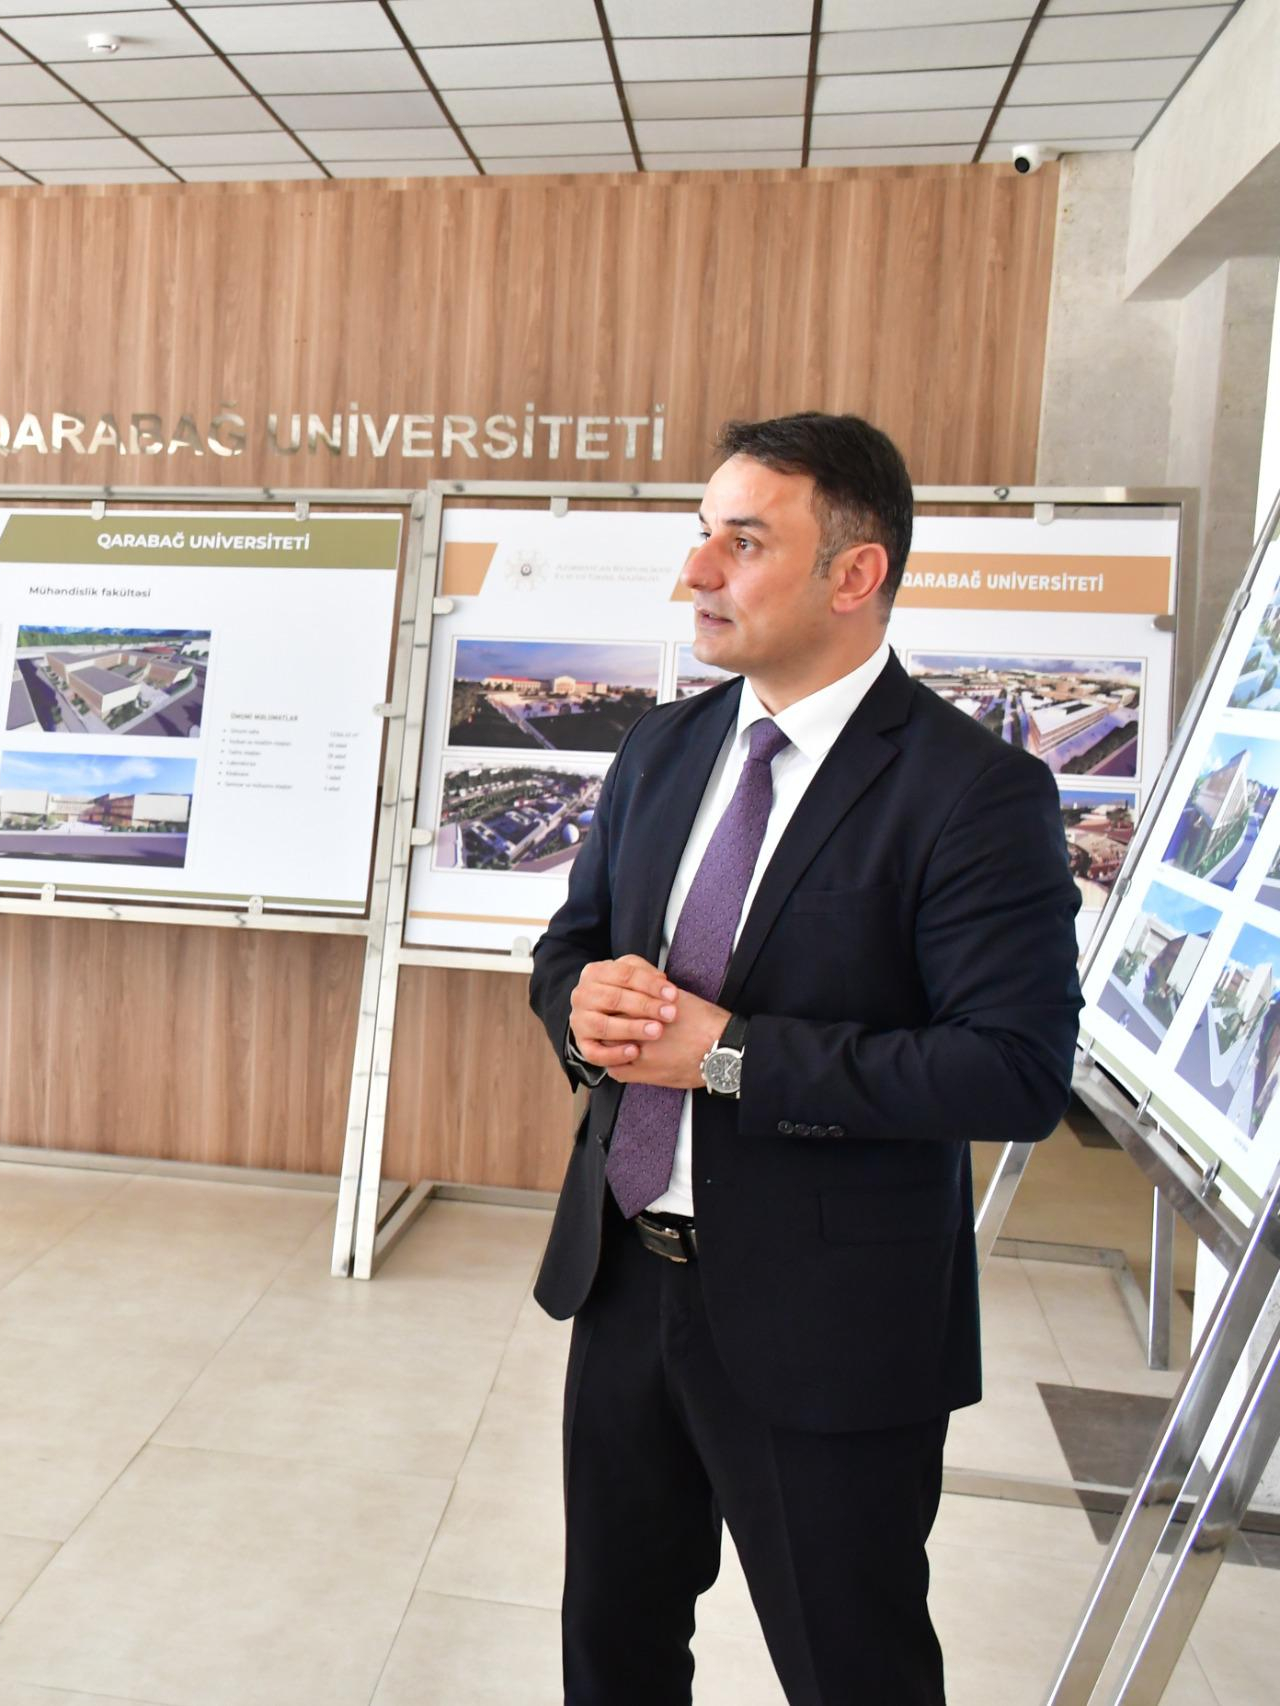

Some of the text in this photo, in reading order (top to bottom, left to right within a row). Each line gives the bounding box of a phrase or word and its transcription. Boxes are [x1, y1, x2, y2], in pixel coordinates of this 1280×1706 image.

[266, 402, 665, 461] UNİVERSİTETİ
[96, 531, 310, 550] QARABAĞ UNİVERSİTETİ
[29, 585, 98, 597] Mühəndislik
[901, 570, 1104, 592] QARABAĞ UNİVERSİTETİ
